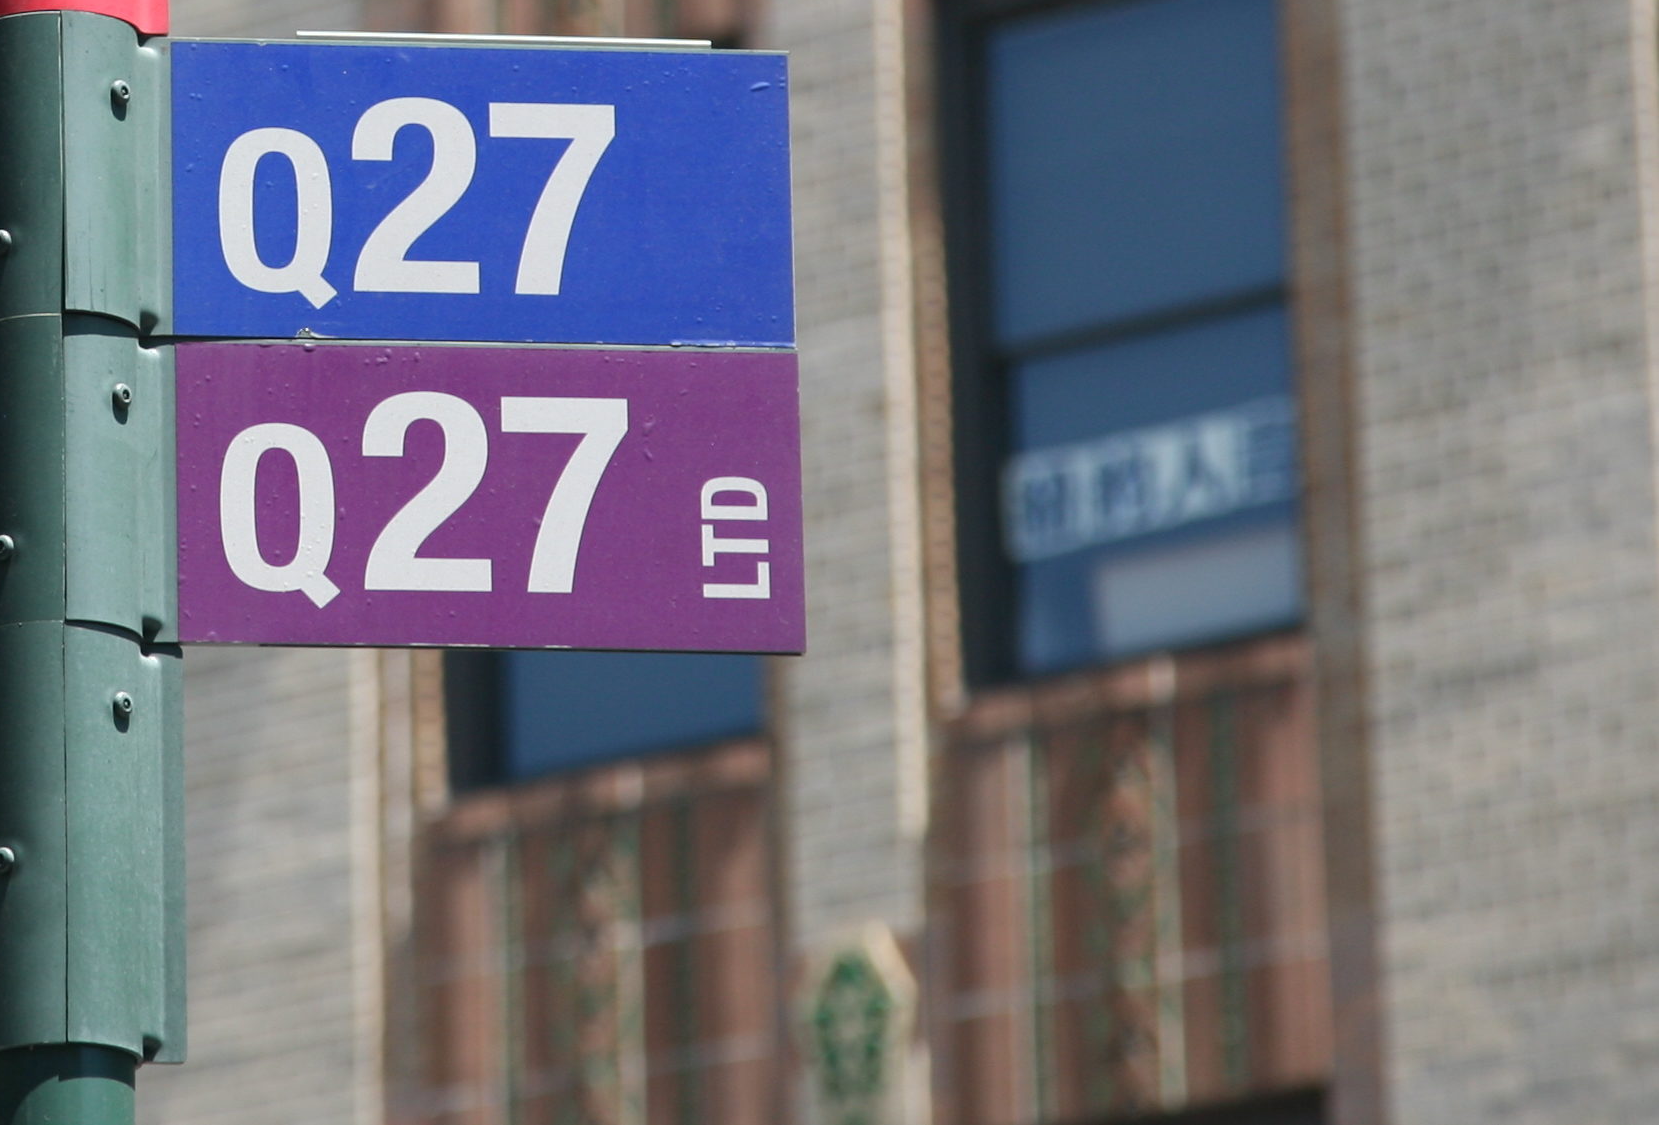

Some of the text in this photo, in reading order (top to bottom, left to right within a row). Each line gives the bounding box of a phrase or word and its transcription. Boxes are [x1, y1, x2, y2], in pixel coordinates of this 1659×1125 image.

[219, 97, 617, 309] Q27
[220, 391, 629, 608] Q27
[701, 477, 770, 598] LTD
